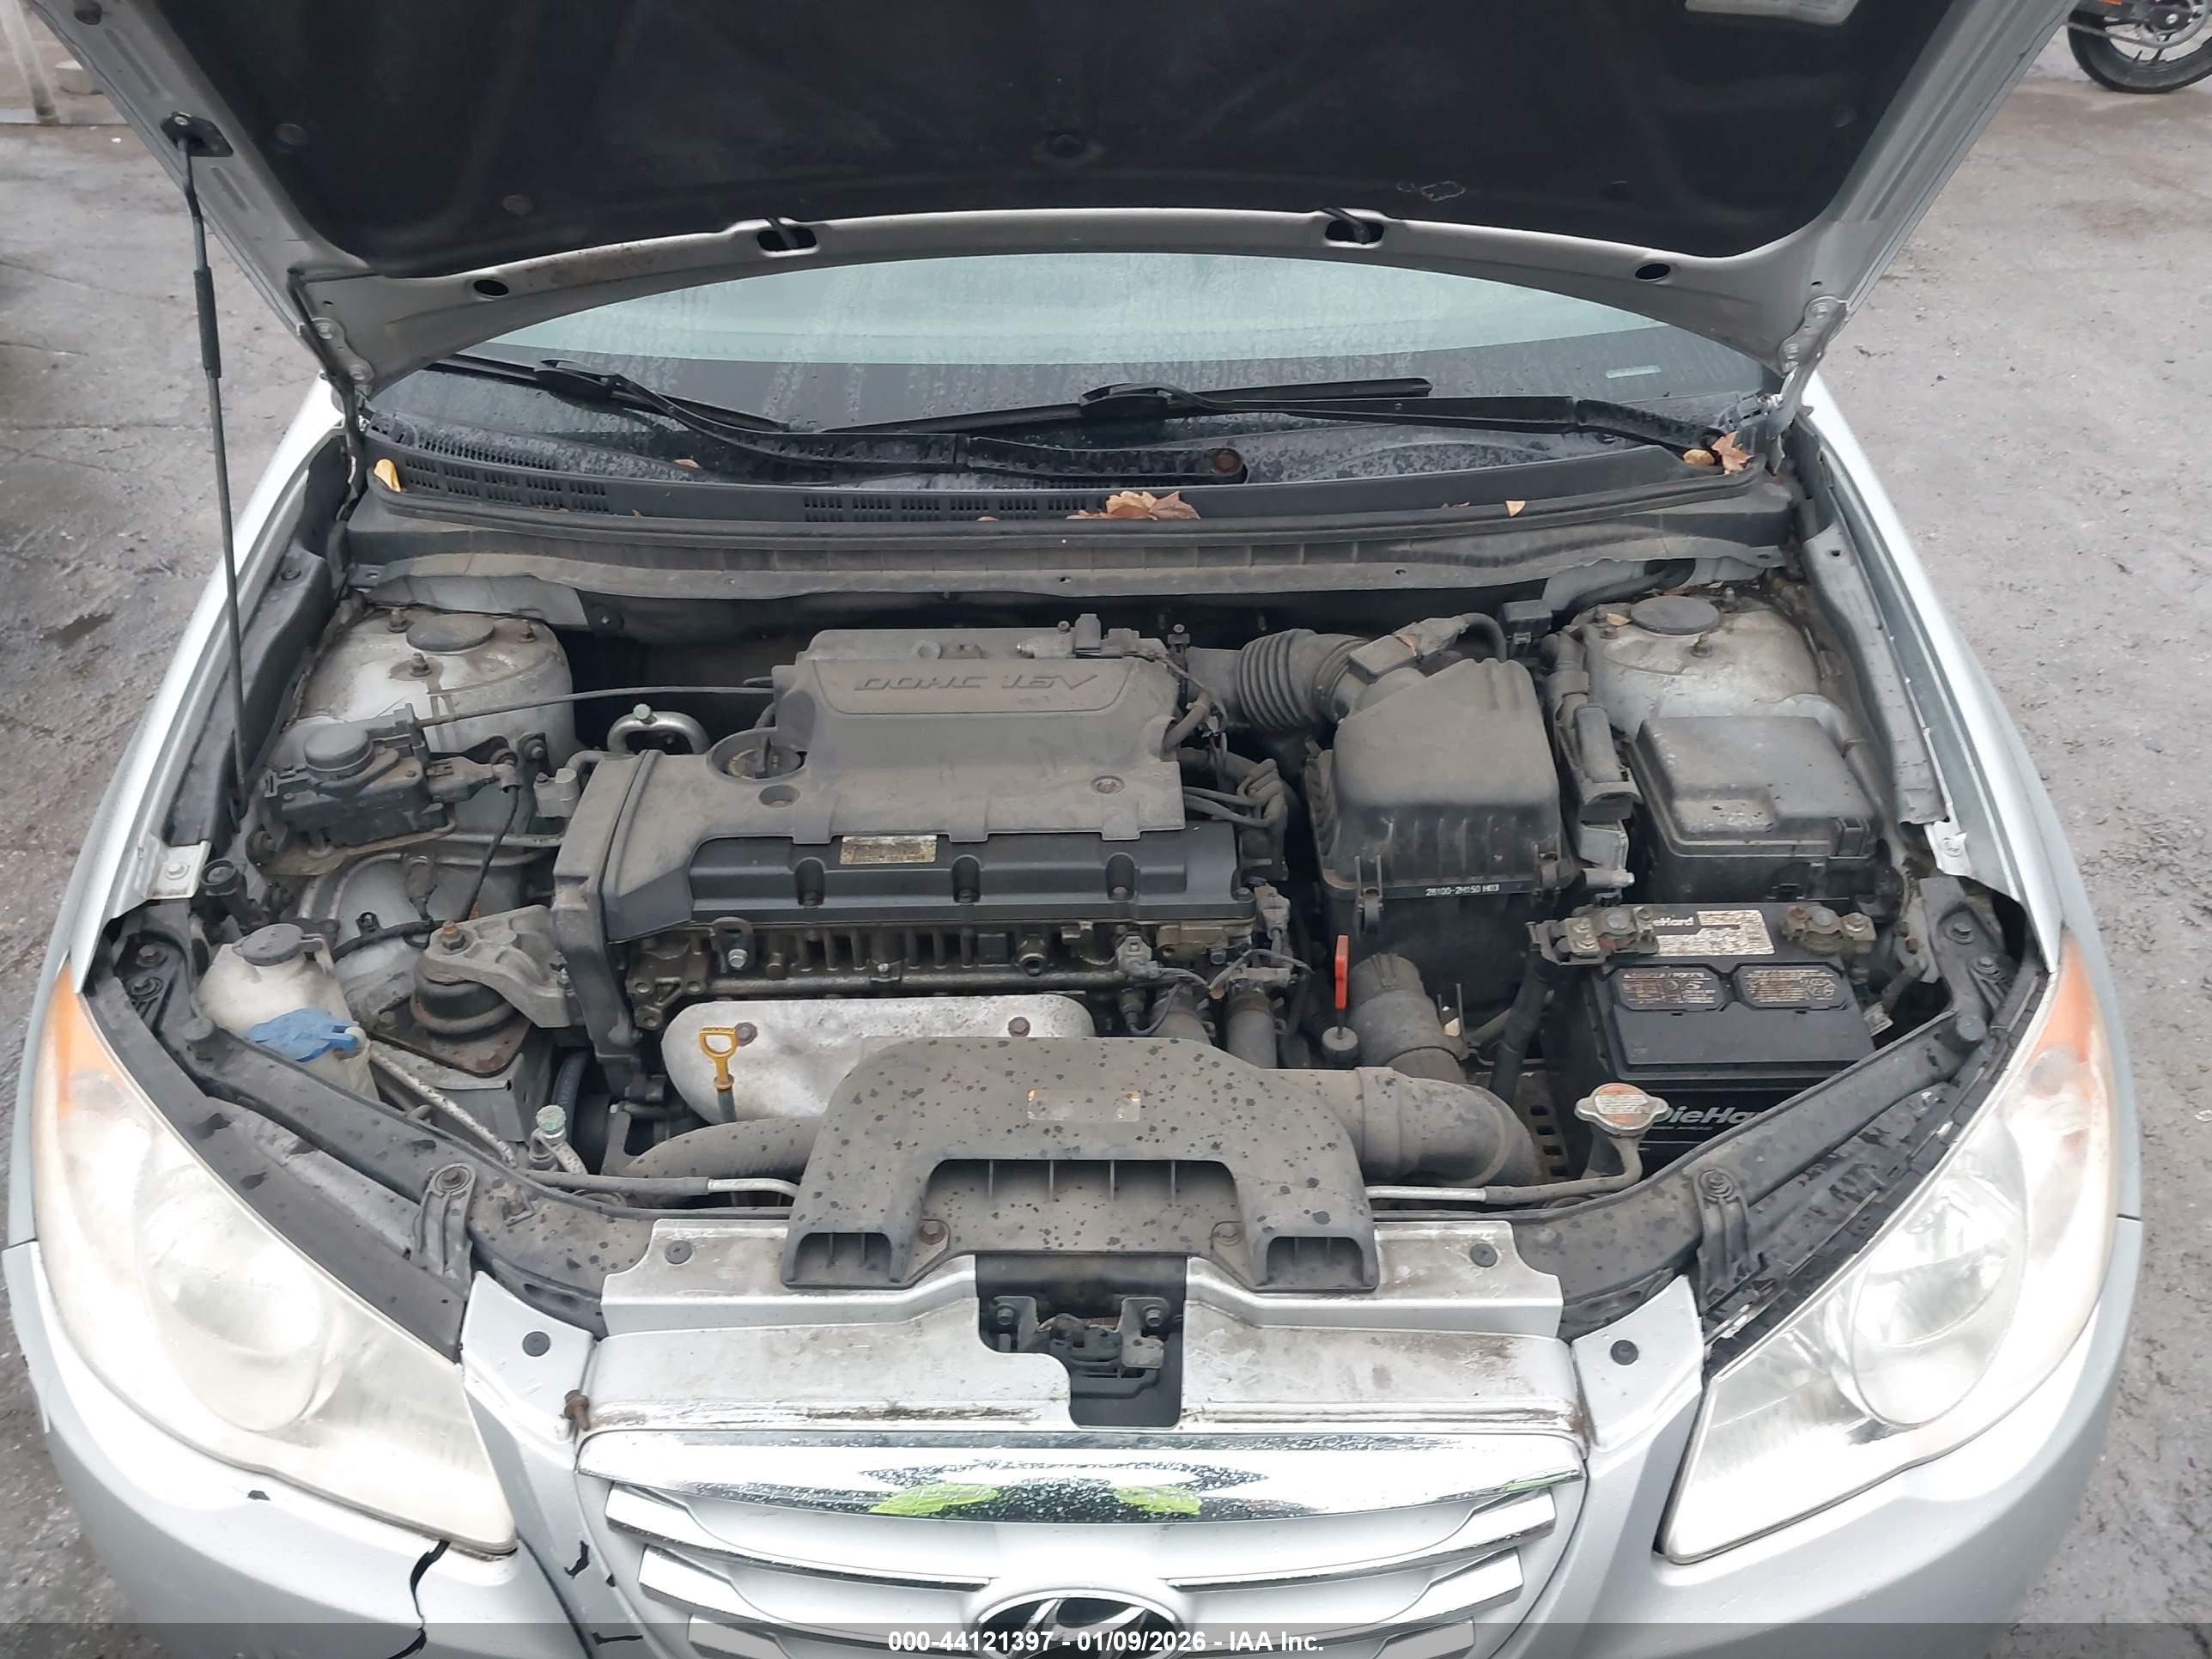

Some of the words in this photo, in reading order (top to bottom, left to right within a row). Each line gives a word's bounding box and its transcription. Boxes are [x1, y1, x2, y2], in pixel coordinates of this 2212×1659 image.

[854, 676, 988, 690] DOHC
[1000, 673, 1098, 690] 16V
[1652, 916, 1694, 927] eHard
